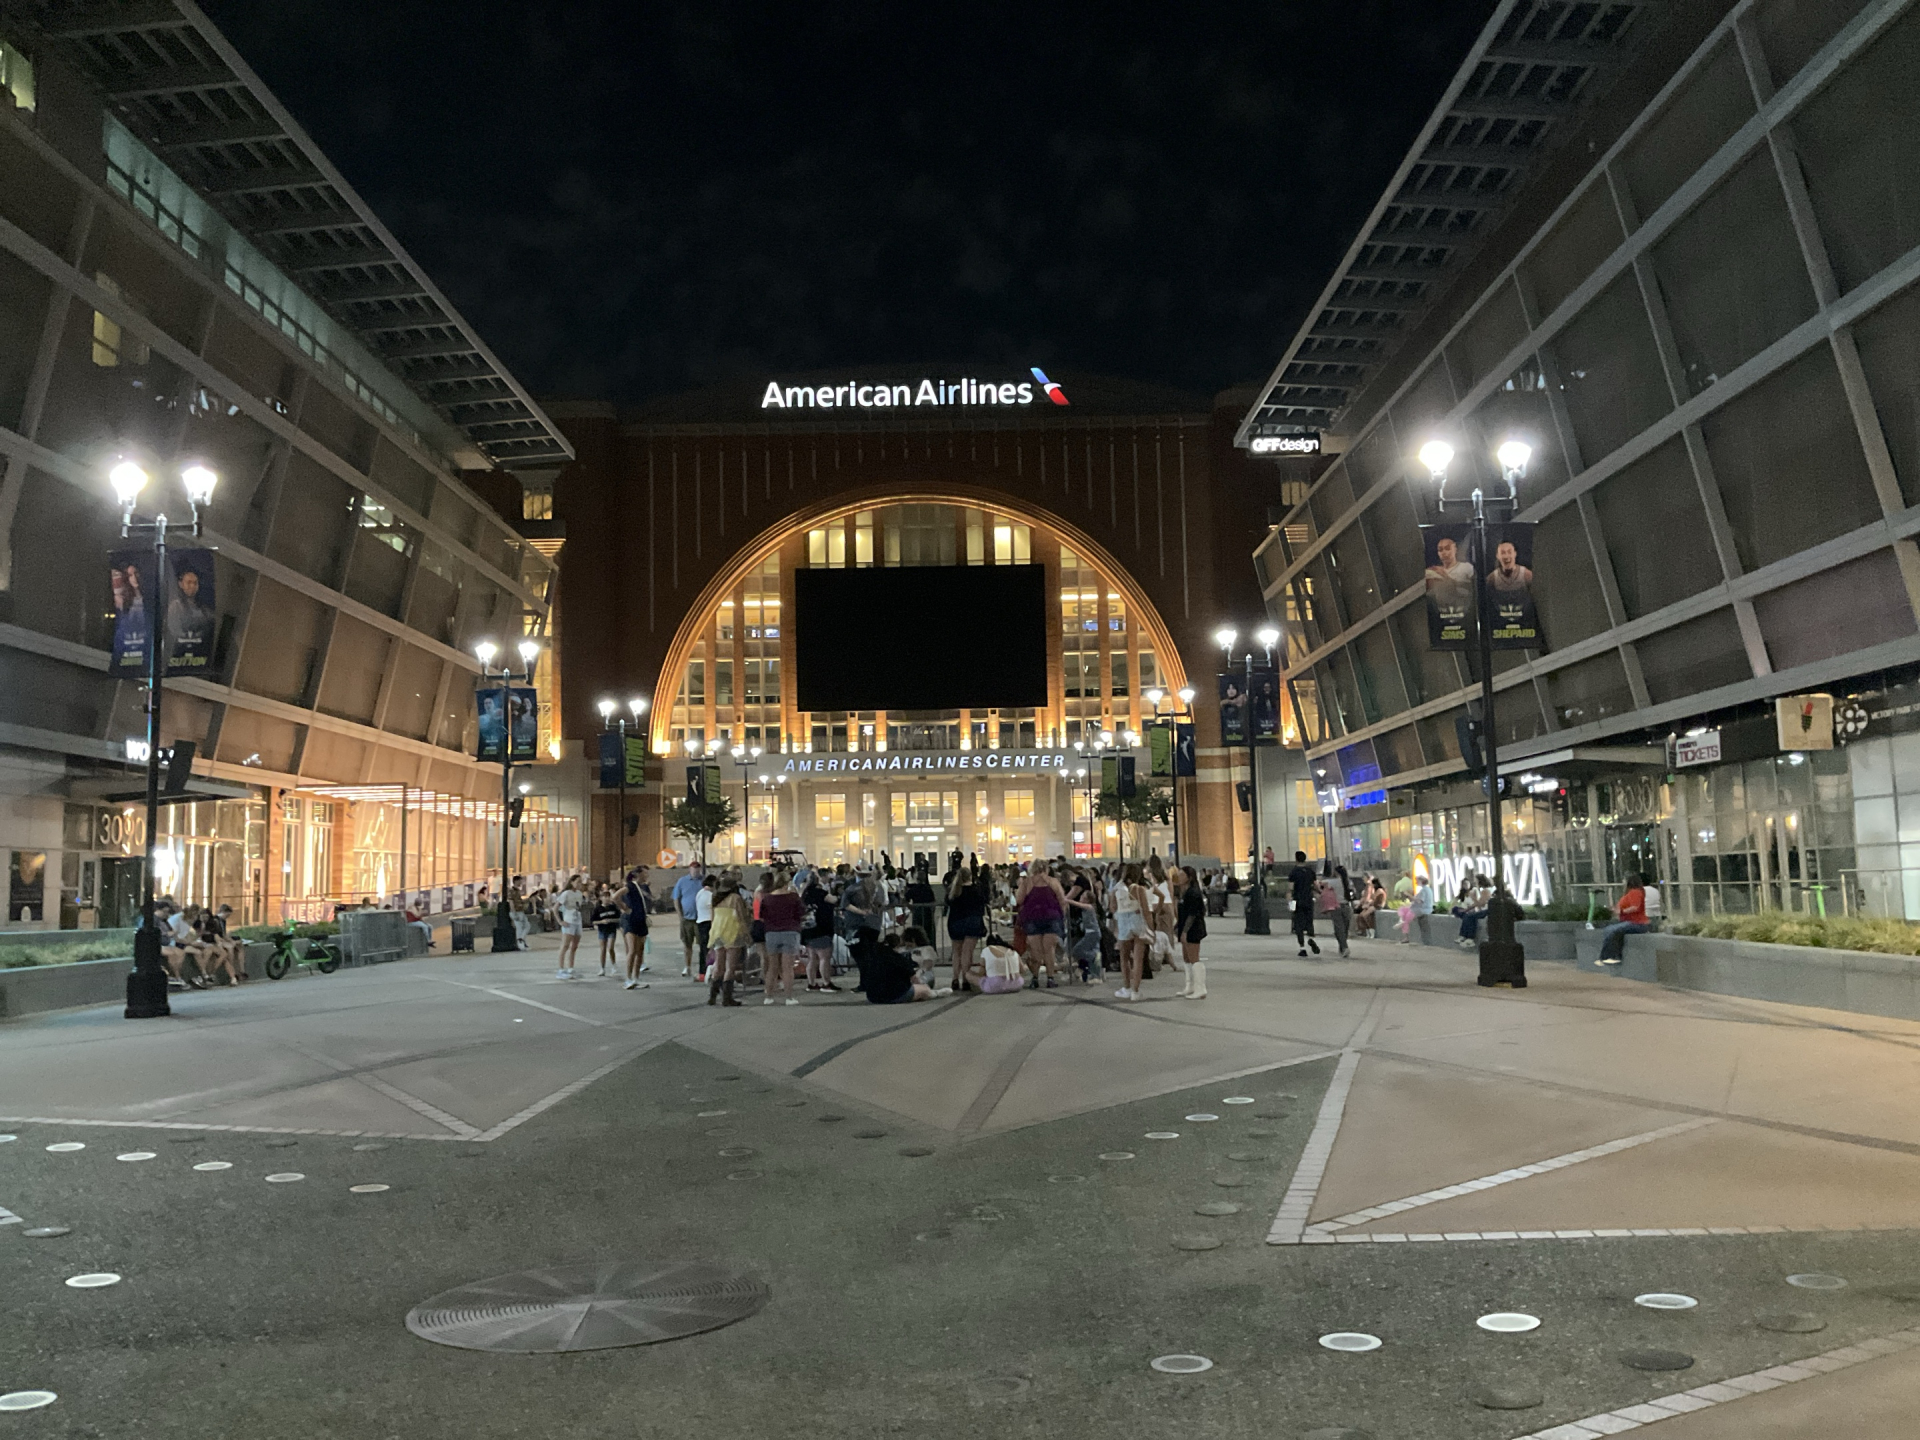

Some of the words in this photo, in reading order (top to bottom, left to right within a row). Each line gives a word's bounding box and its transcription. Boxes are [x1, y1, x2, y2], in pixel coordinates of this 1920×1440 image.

[761, 381, 911, 408] American
[914, 377, 1034, 406] Airlines
[1441, 630, 1466, 640] SIMS
[1679, 745, 1719, 762] TICKETS
